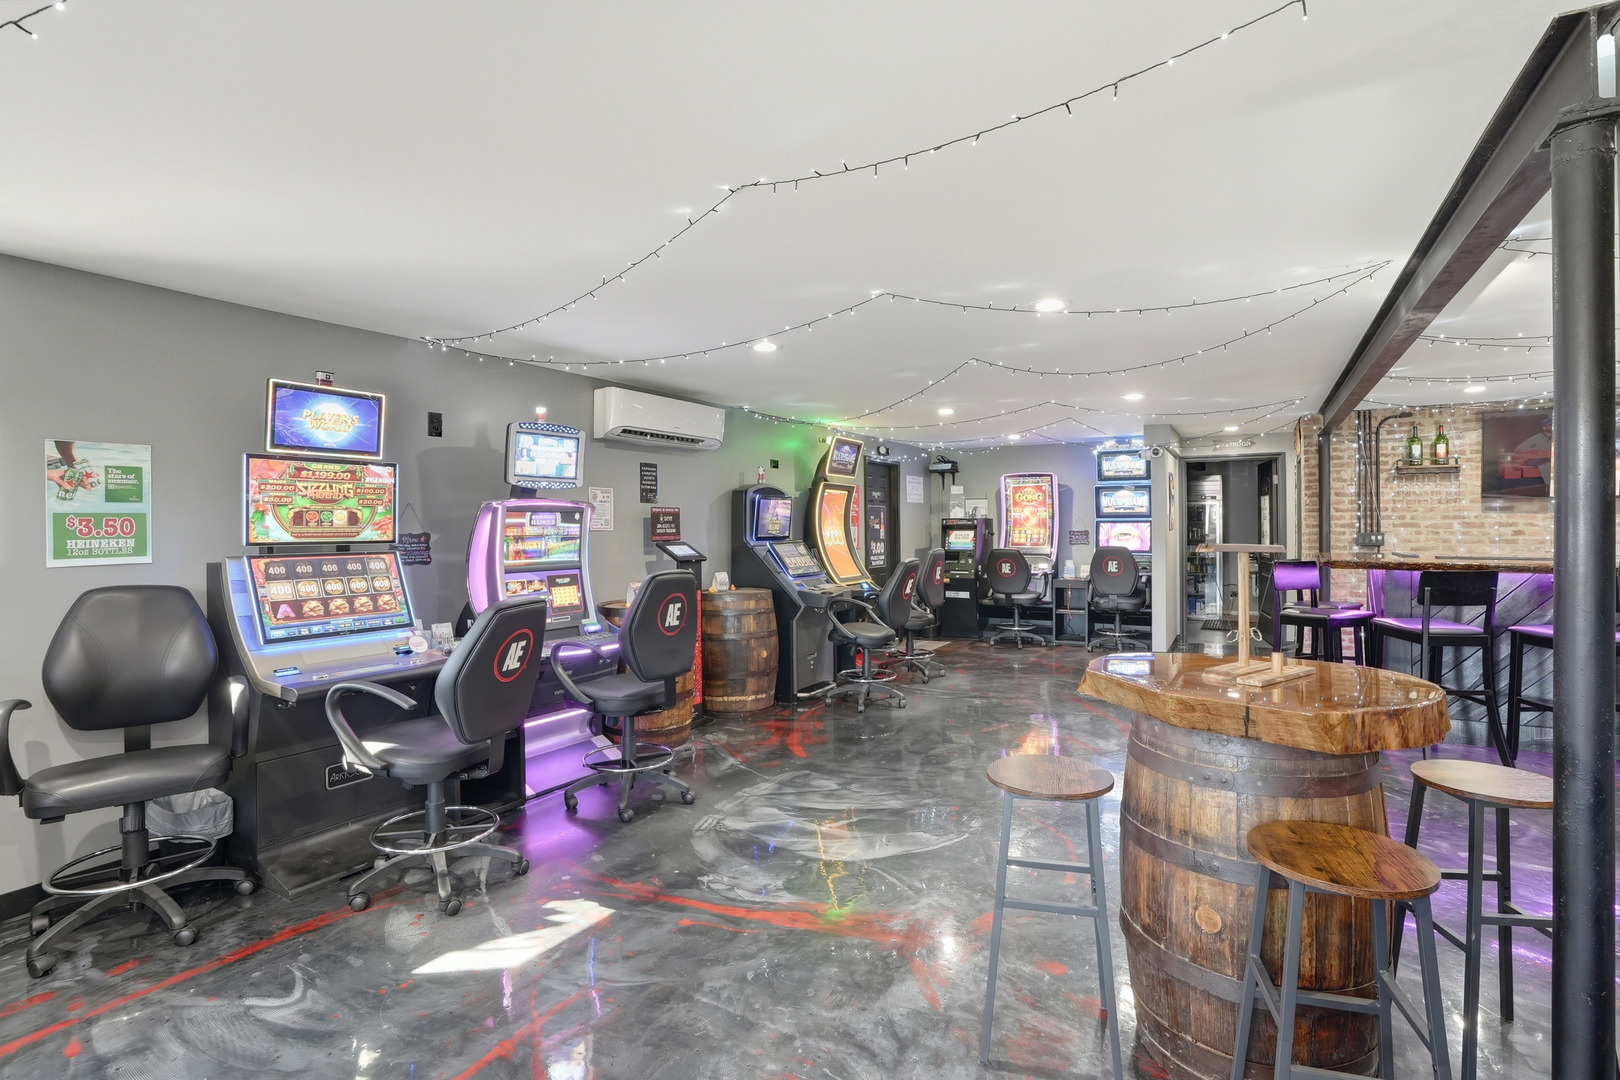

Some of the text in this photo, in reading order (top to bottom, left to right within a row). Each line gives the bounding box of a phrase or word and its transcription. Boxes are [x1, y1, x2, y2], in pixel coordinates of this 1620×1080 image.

[302, 409, 360, 425] PLAYER'S
[309, 419, 353, 433] WORLD
[296, 480, 354, 497] SIZZLING
[1015, 492, 1044, 502] GONG
[66, 515, 135, 538] $3.50
[66, 539, 136, 549] HEINEKEN
[67, 546, 133, 556] 12oz BOTTLES
[268, 561, 387, 575] 400 400 400 400 400
[1001, 562, 1012, 574] AE
[1108, 560, 1118, 572] AE
[270, 579, 389, 596] 400 400 400 400 400
[664, 602, 681, 627] AE
[502, 640, 527, 672] AE
